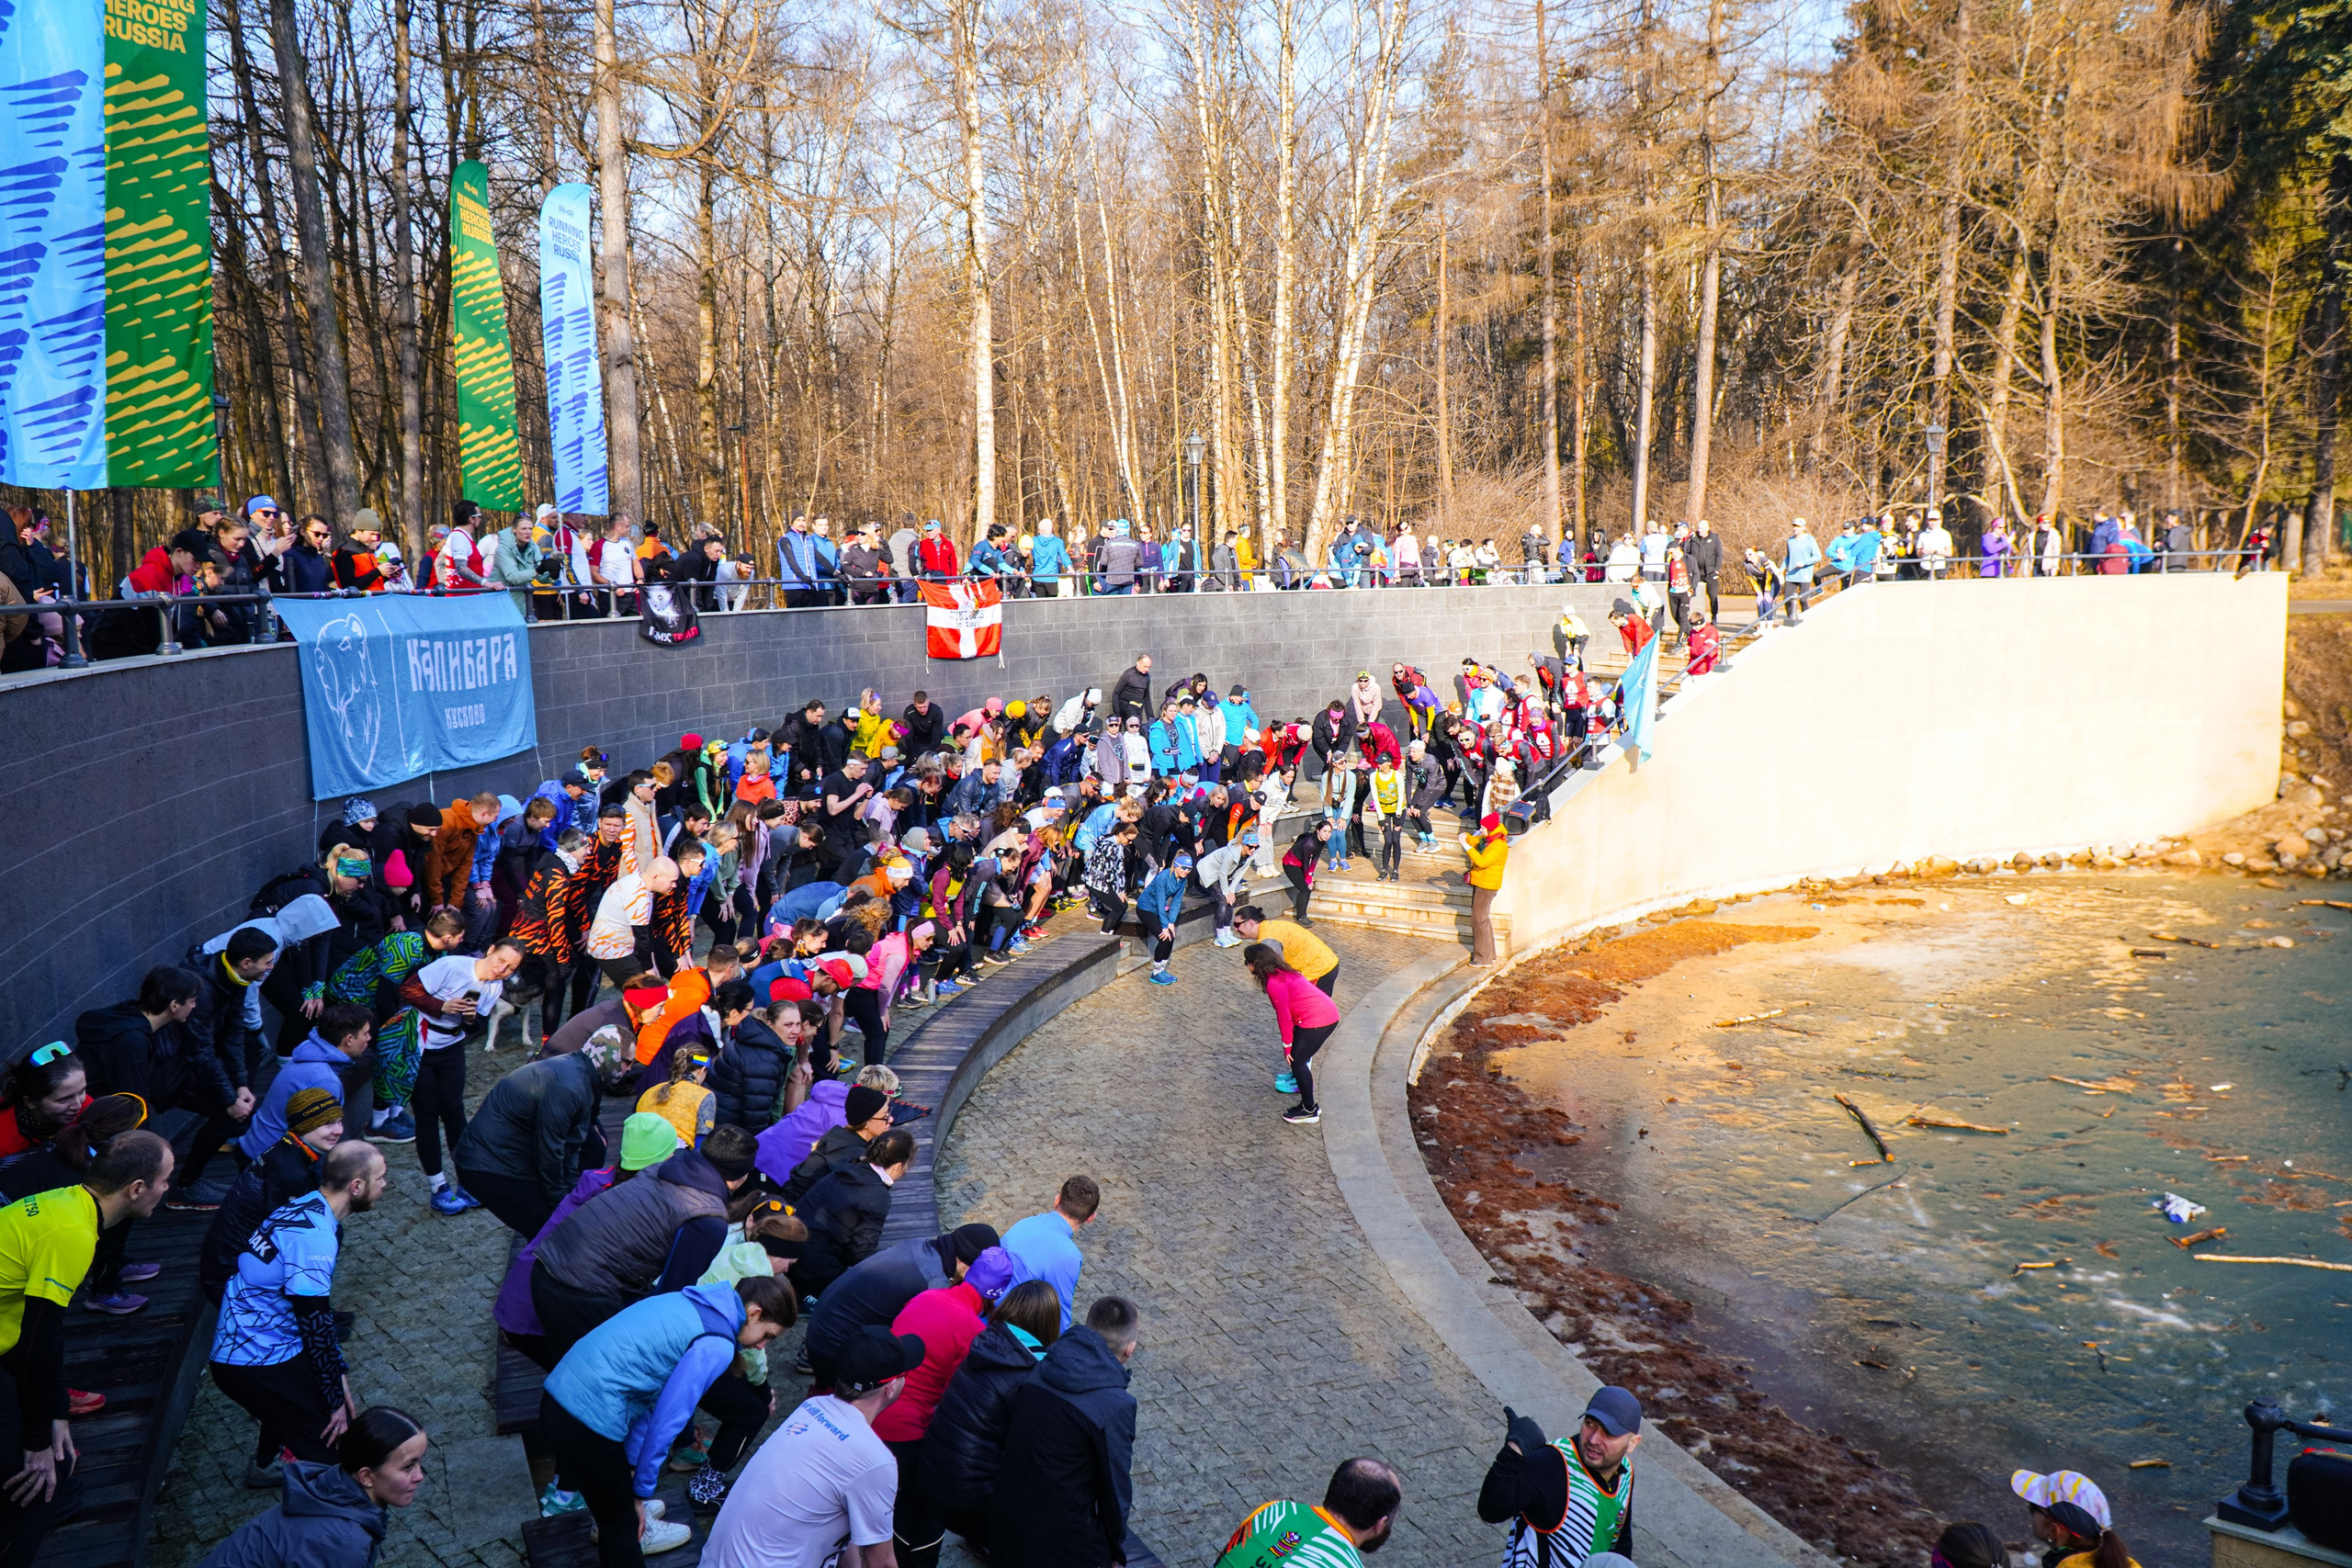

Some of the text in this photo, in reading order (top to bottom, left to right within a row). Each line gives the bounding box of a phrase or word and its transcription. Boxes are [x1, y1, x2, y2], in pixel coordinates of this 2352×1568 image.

[105, 15, 187, 54] RUSSIA
[457, 192, 490, 221] RUNNING
[460, 208, 492, 233] HEROES
[462, 221, 494, 246] RUSSIA
[548, 217, 584, 242] RUNNING
[552, 230, 582, 253] HEROES
[553, 244, 581, 265] RUSSIA
[406, 632, 518, 693] КАПИБАРА
[445, 703, 486, 730] КУСКОВО
[815, 1413, 850, 1442] forward
